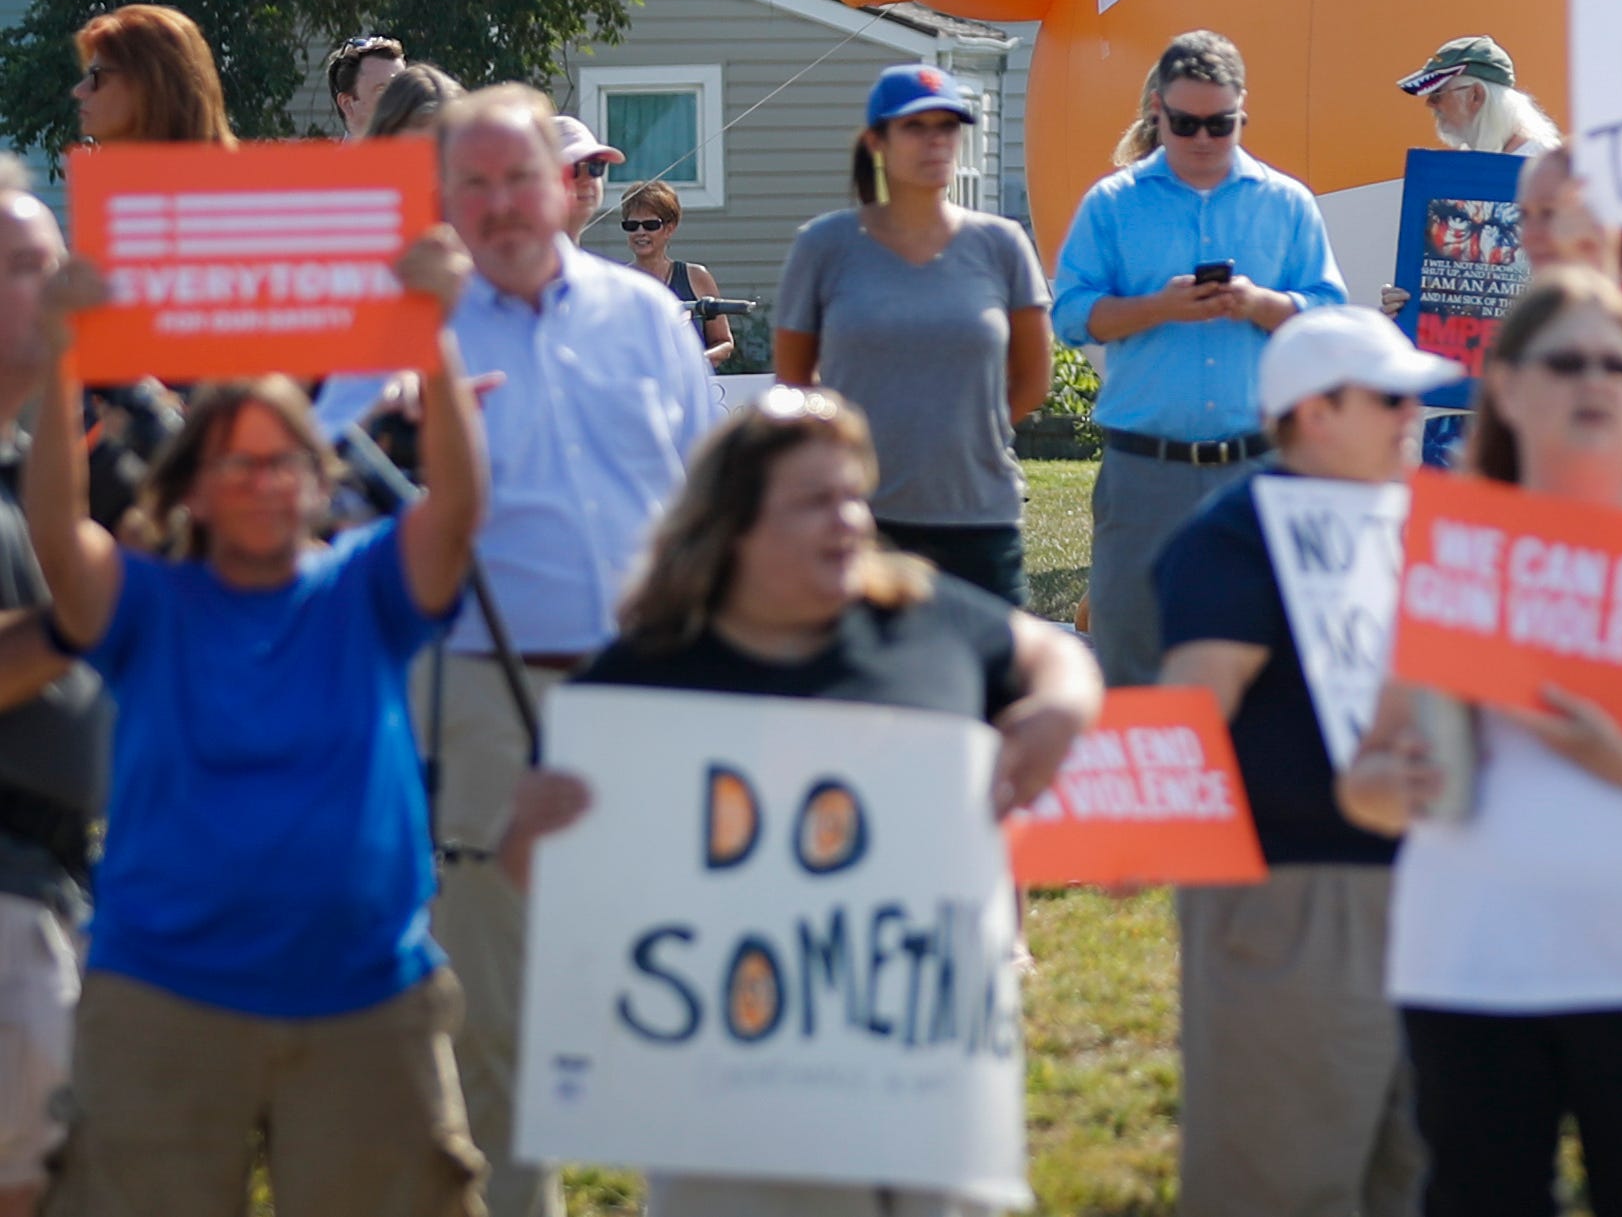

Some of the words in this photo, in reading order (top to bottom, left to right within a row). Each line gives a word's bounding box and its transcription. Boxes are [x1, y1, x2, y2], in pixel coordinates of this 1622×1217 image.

[1420, 276, 1427, 289] I
[1429, 277, 1456, 290] AM
[1459, 279, 1484, 292] AN
[1421, 267, 1446, 276] SHUT
[1462, 270, 1485, 279] AND
[1492, 272, 1518, 282] WILL
[1424, 259, 1428, 267] I
[1429, 259, 1451, 268] WILL
[1453, 261, 1474, 270] NOT
[1475, 262, 1490, 271] SIT
[1420, 292, 1441, 302] AND
[1446, 294, 1462, 303] AM
[1463, 295, 1483, 305] SICK
[1484, 297, 1497, 307] OF
[1288, 508, 1355, 573] NO
[1432, 518, 1503, 580] WE
[1508, 536, 1606, 597] CAN
[1404, 563, 1498, 633] GUN
[1126, 725, 1205, 769] END
[703, 759, 870, 876] DO
[1064, 768, 1237, 821] VIOLENCE
